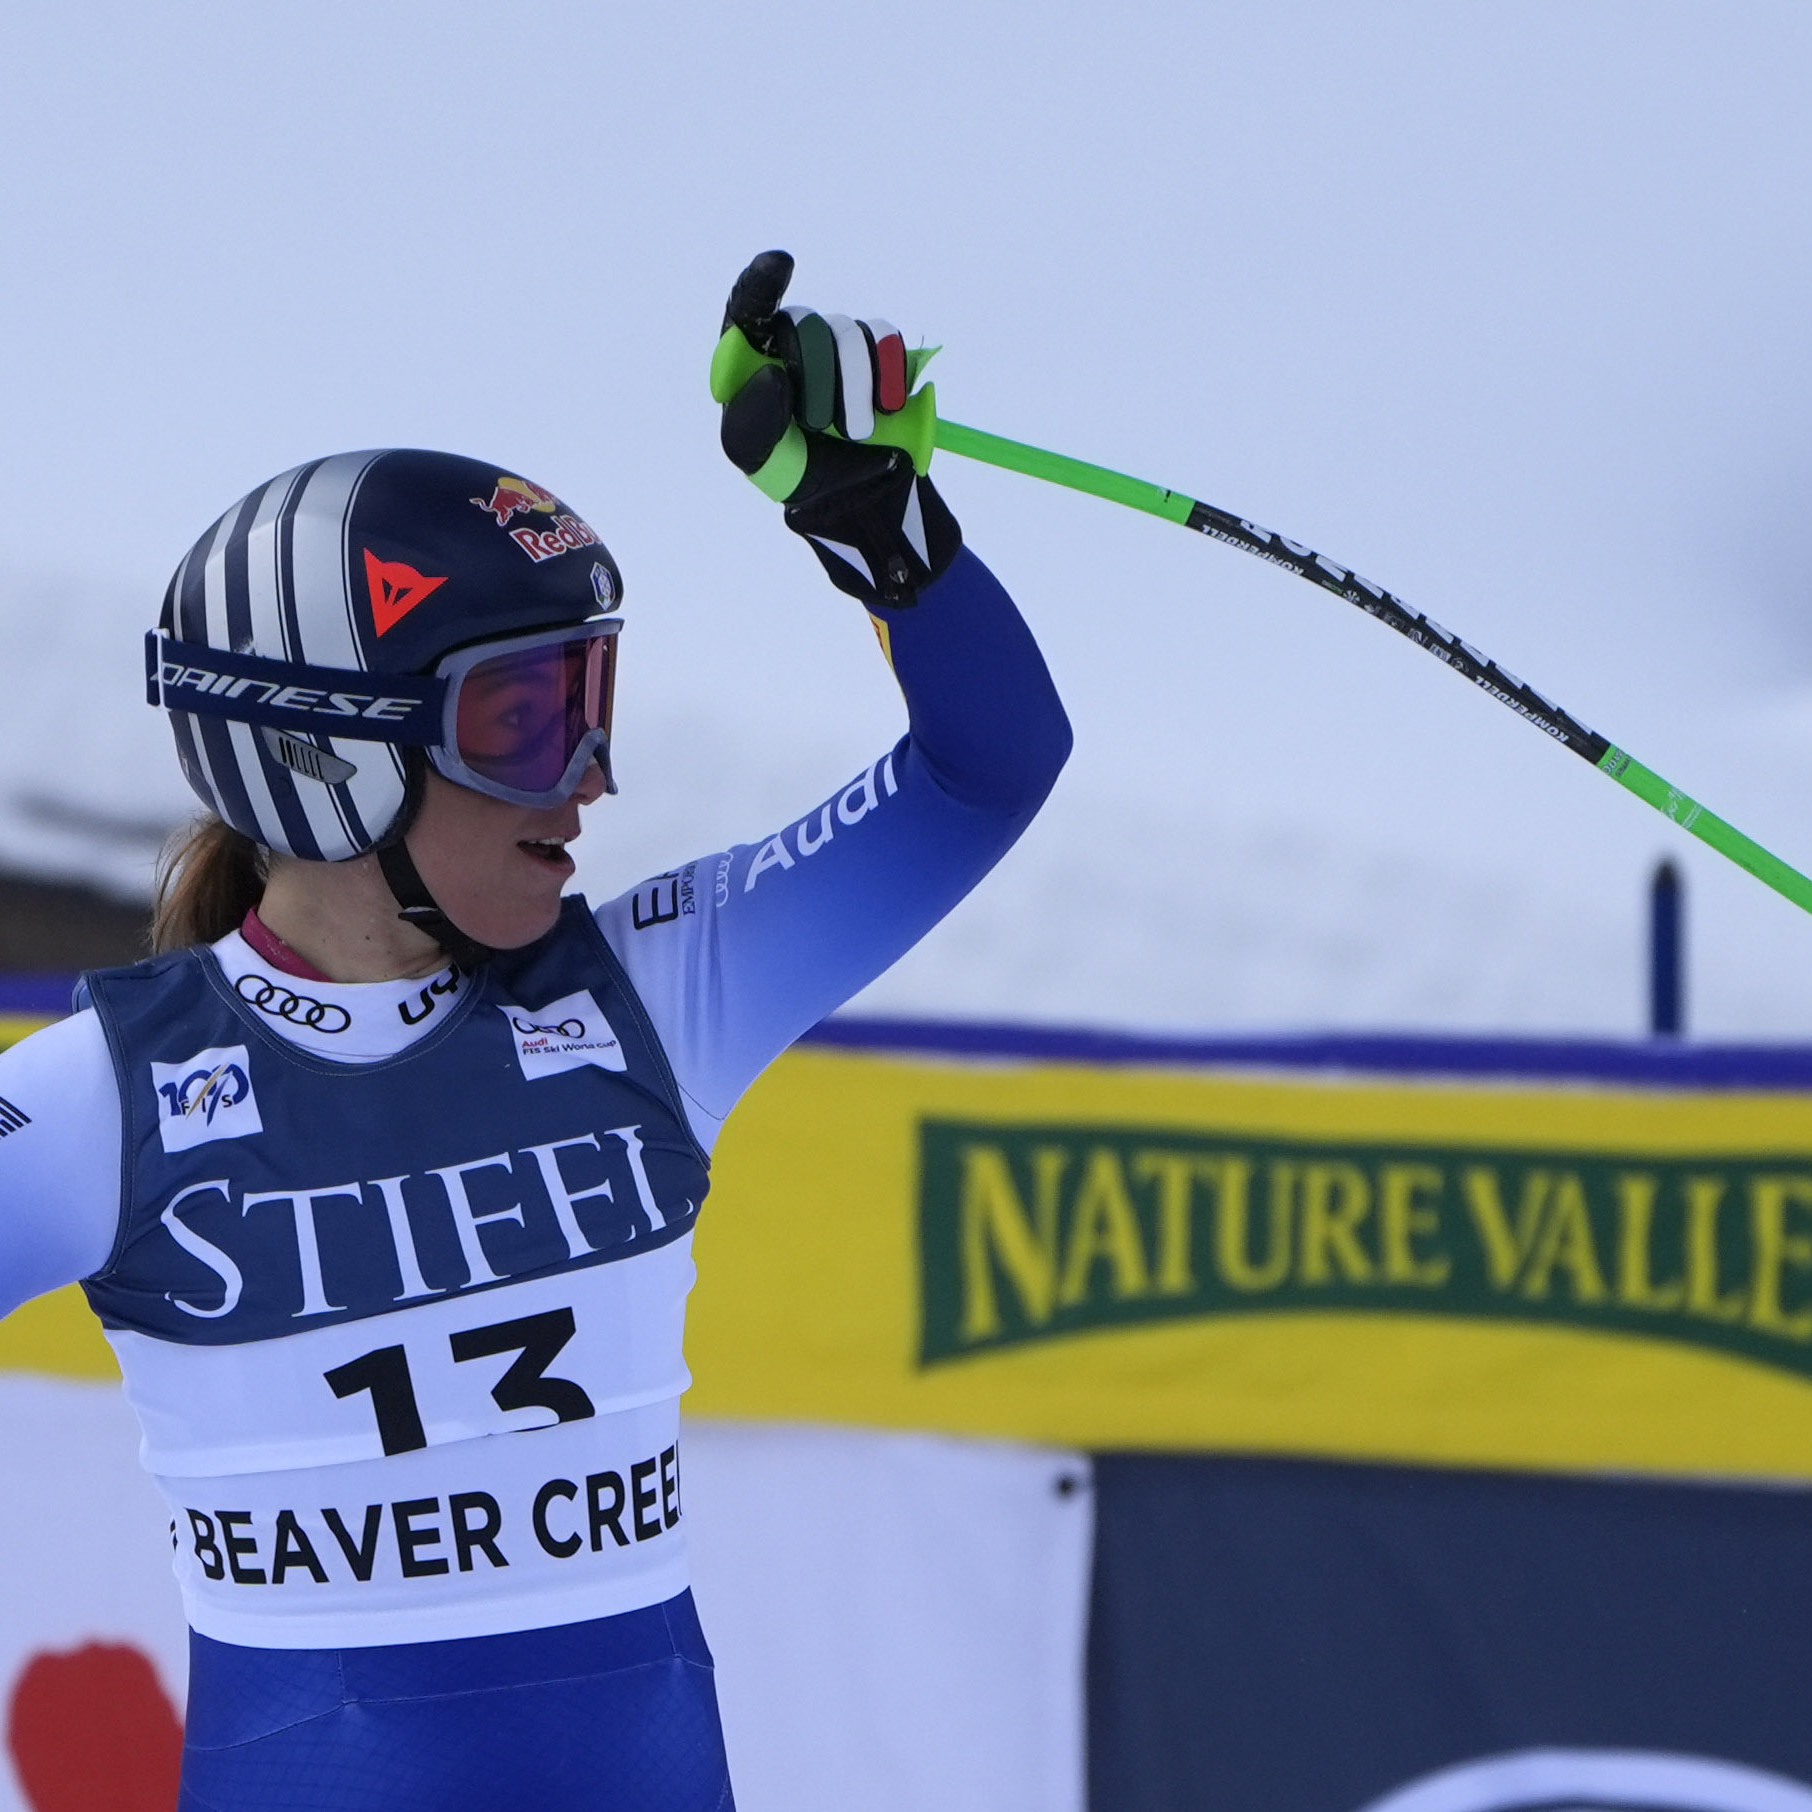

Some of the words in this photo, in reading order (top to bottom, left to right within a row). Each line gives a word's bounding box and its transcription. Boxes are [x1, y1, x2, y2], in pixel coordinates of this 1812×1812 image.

[150, 661, 423, 720] DAINESE
[1475, 675, 1570, 743] KOMPERDELL
[743, 754, 899, 893] Audi
[957, 1144, 1450, 1343] NATURE
[323, 1306, 596, 1457] 13
[185, 1490, 510, 1585] BEAVER
[532, 1439, 683, 1560] CREE
